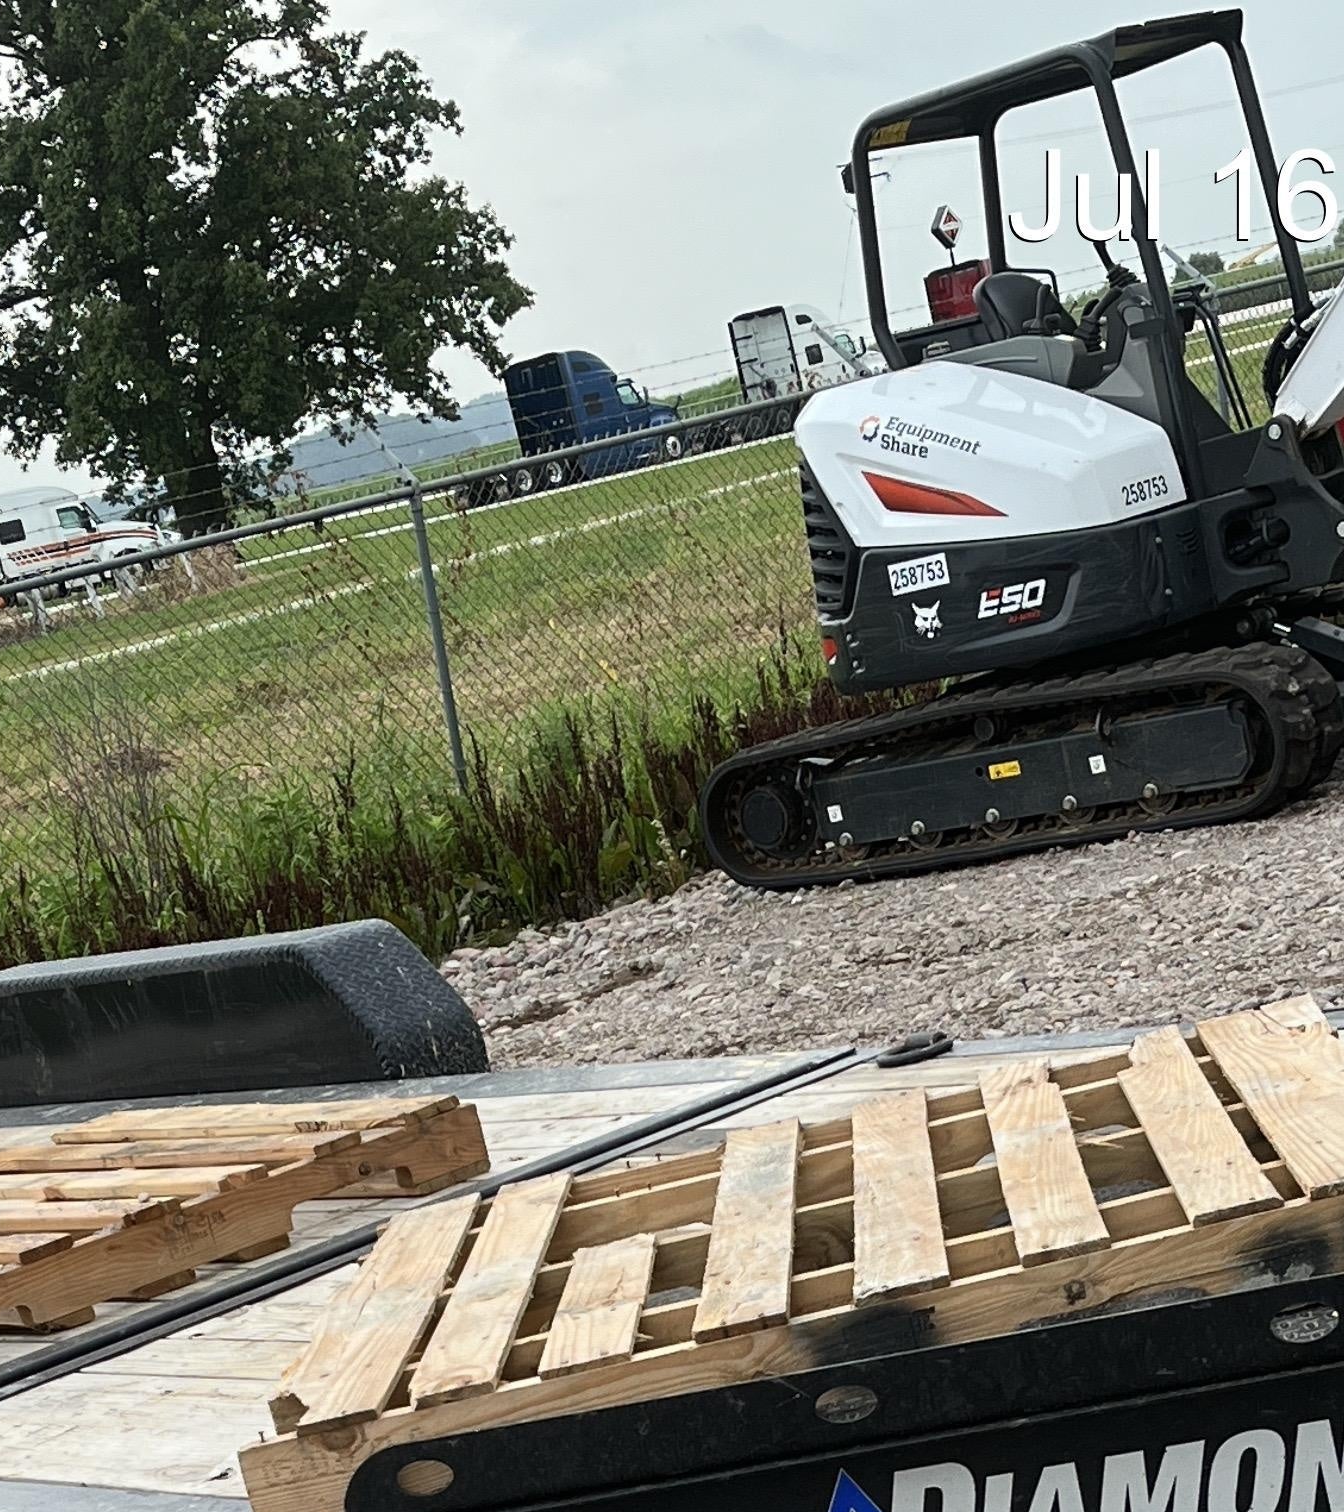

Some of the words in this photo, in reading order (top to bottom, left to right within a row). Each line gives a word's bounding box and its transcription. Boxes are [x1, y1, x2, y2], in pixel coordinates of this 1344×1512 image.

[880, 434, 929, 459] Share
[884, 416, 983, 455] Equipment
[1121, 475, 1169, 506] 258753
[891, 559, 946, 591] 258753
[977, 578, 1047, 619] E50
